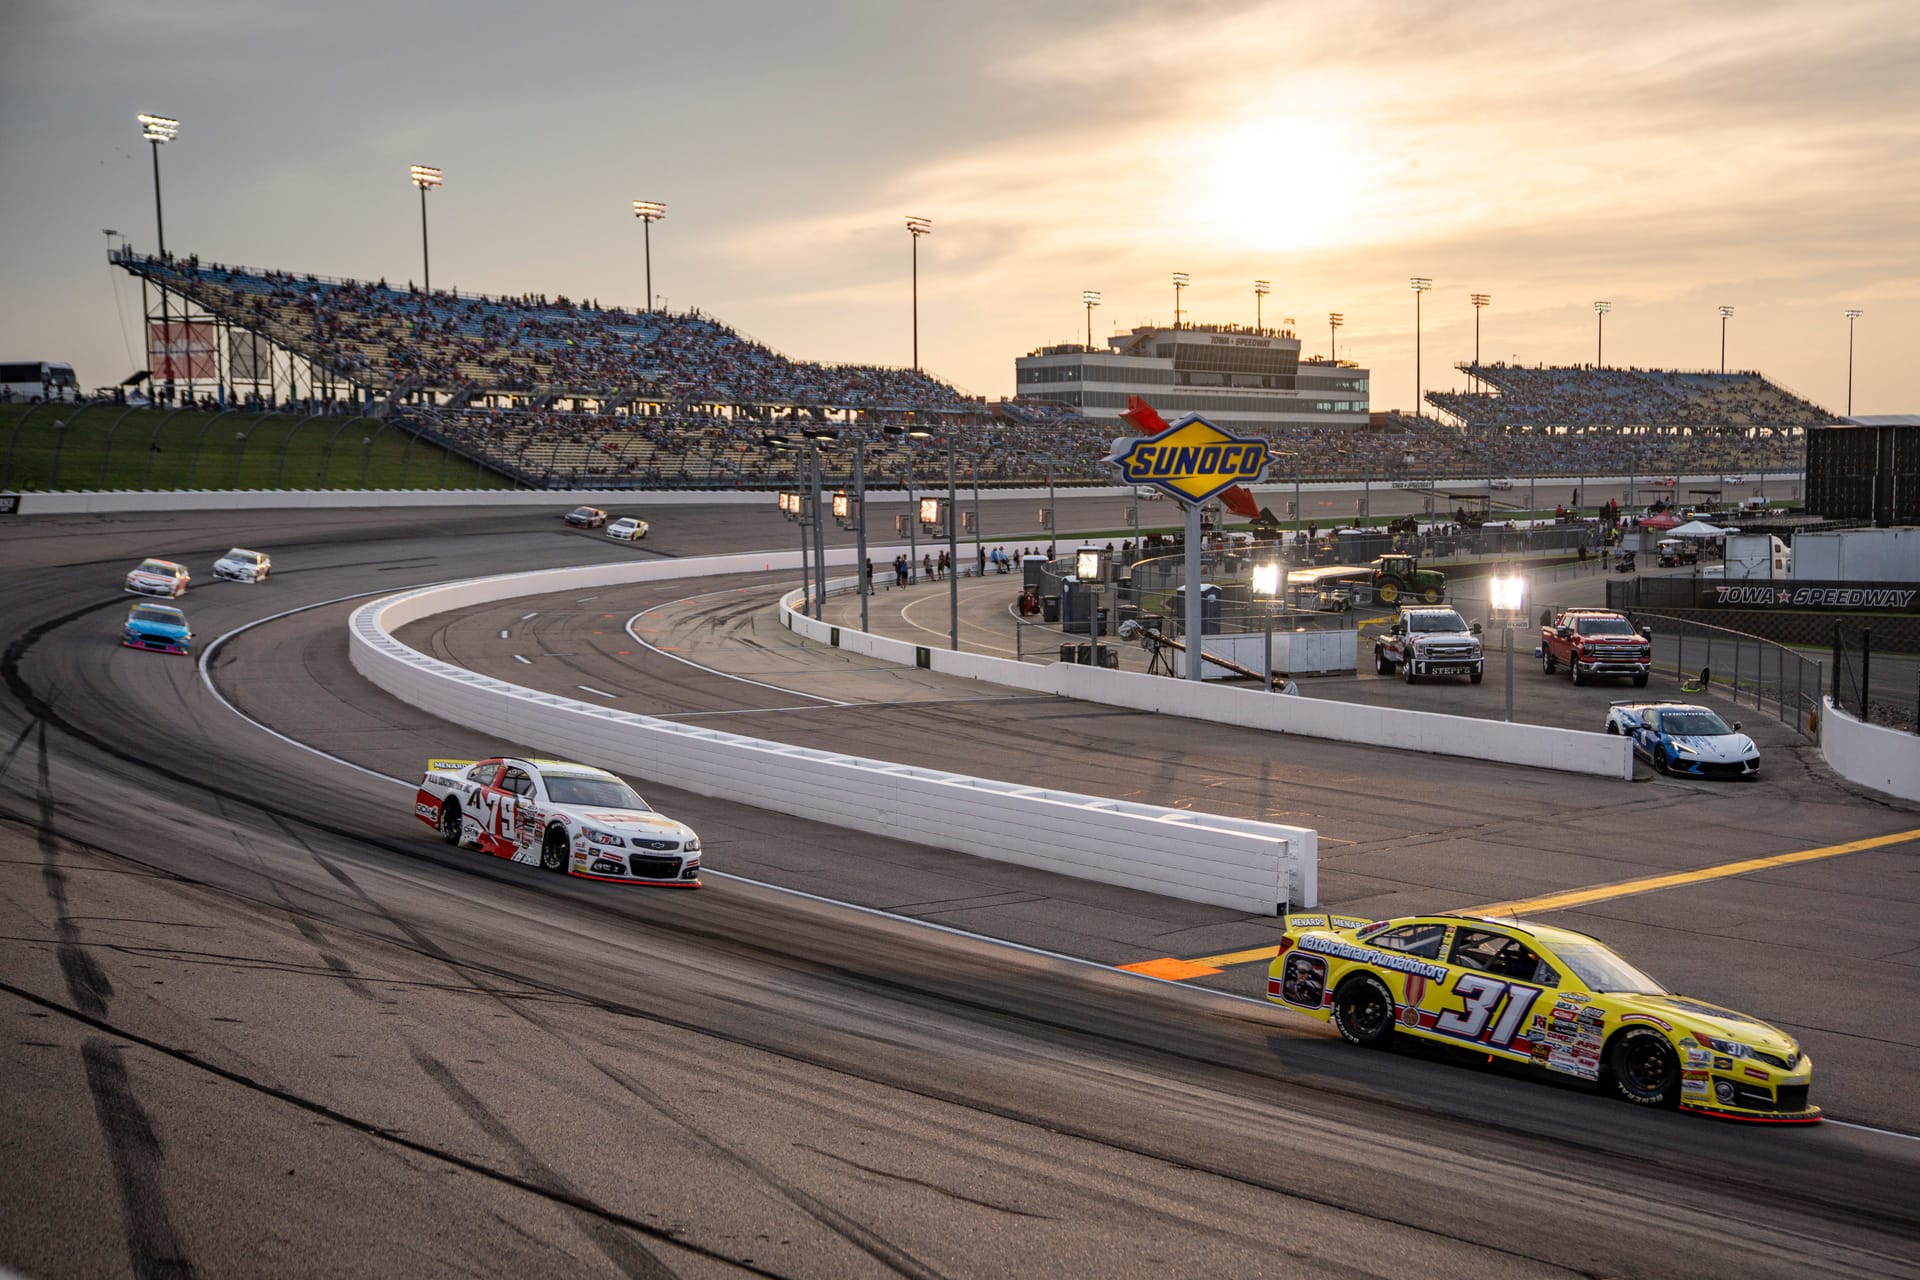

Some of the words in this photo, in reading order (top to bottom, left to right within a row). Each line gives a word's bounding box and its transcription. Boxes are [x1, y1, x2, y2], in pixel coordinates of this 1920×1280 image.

[1131, 447, 1263, 475] SUNOCO
[1716, 586, 1774, 604] IOWA
[1793, 588, 1917, 607] SPEEDWAY
[1418, 662, 1426, 674] 1
[1476, 661, 1482, 673] 1
[486, 792, 516, 841] 79
[1291, 918, 1325, 927] MENARDS
[1333, 918, 1368, 929] MENAR
[1436, 973, 1543, 1047] 31
[1727, 1043, 1742, 1056] 31
